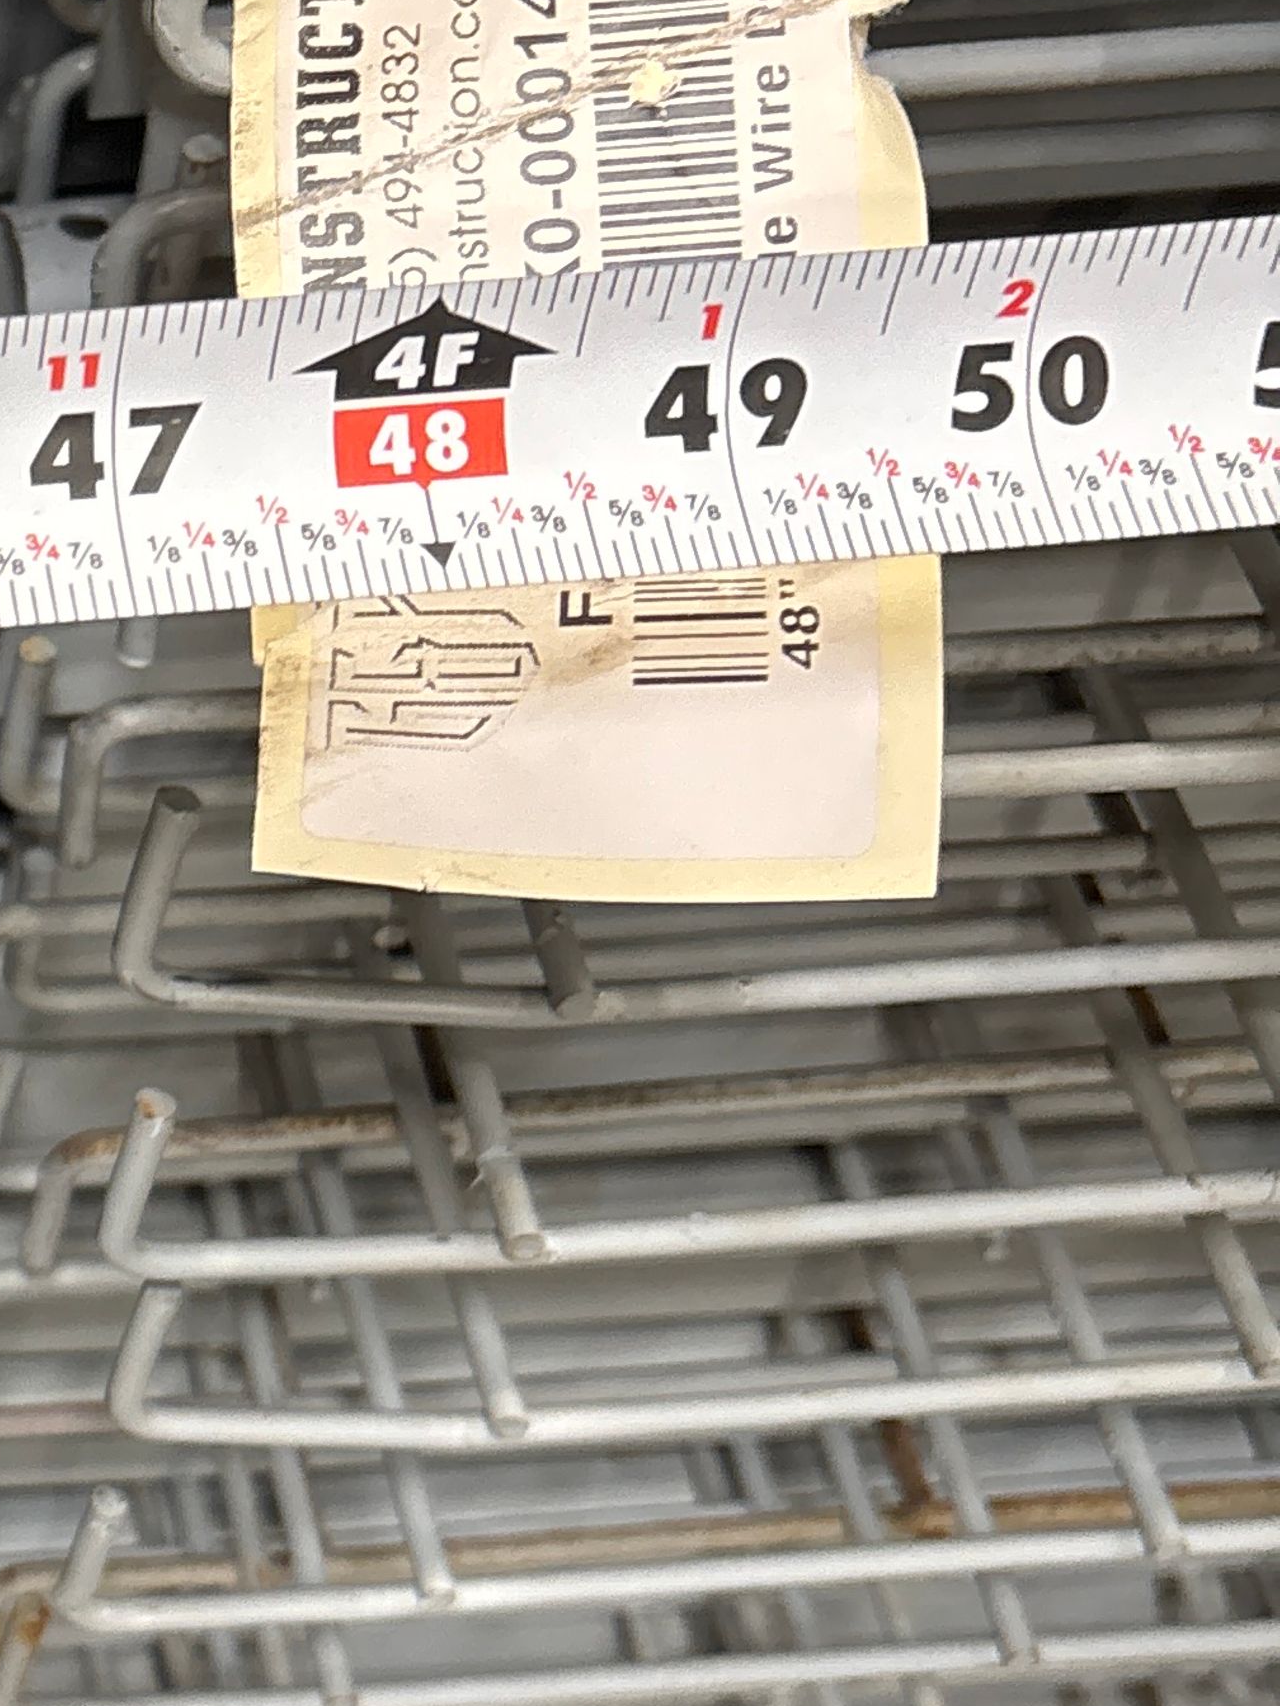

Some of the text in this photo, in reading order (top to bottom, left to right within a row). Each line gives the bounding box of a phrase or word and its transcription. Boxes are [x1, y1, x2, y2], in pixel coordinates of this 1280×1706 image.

[750, 63, 794, 193] Wire
[47, 352, 102, 391] 11
[701, 302, 724, 341] 1
[996, 278, 1036, 318] 2
[374, 332, 480, 389] 4F
[29, 402, 203, 500] 47
[368, 408, 469, 475] 48
[643, 357, 808, 453] 49
[950, 335, 1110, 432] 50
[24, 533, 60, 563] 3/4
[68, 540, 103, 571] 7/8
[148, 534, 182, 565] 1/8
[182, 521, 215, 550] 1/4
[221, 527, 256, 558] 3/8
[255, 495, 289, 526] 1/2
[300, 521, 336, 553] 5/8
[334, 507, 370, 537] 3/4
[378, 515, 414, 545] 7/8
[457, 509, 491, 541] 1/8
[490, 496, 524, 526] 1/4
[530, 503, 566, 534] 3/8
[562, 470, 597, 501] 1/2
[607, 497, 645, 528] 5/8
[642, 483, 678, 514] 3/4
[683, 492, 722, 523] 7/8
[764, 486, 798, 517] 1/8
[794, 472, 829, 502] 1/4
[835, 480, 874, 511] 3/8
[865, 446, 900, 479] 1/2
[912, 474, 950, 505] 5/8
[944, 460, 981, 490] 3/4
[986, 468, 1025, 498] 7/8
[1066, 462, 1101, 492] 1/8
[1097, 447, 1134, 478] 1/4
[1138, 457, 1177, 487] 3/8
[1168, 422, 1205, 455] 1/2
[1215, 450, 1255, 480] 5/8
